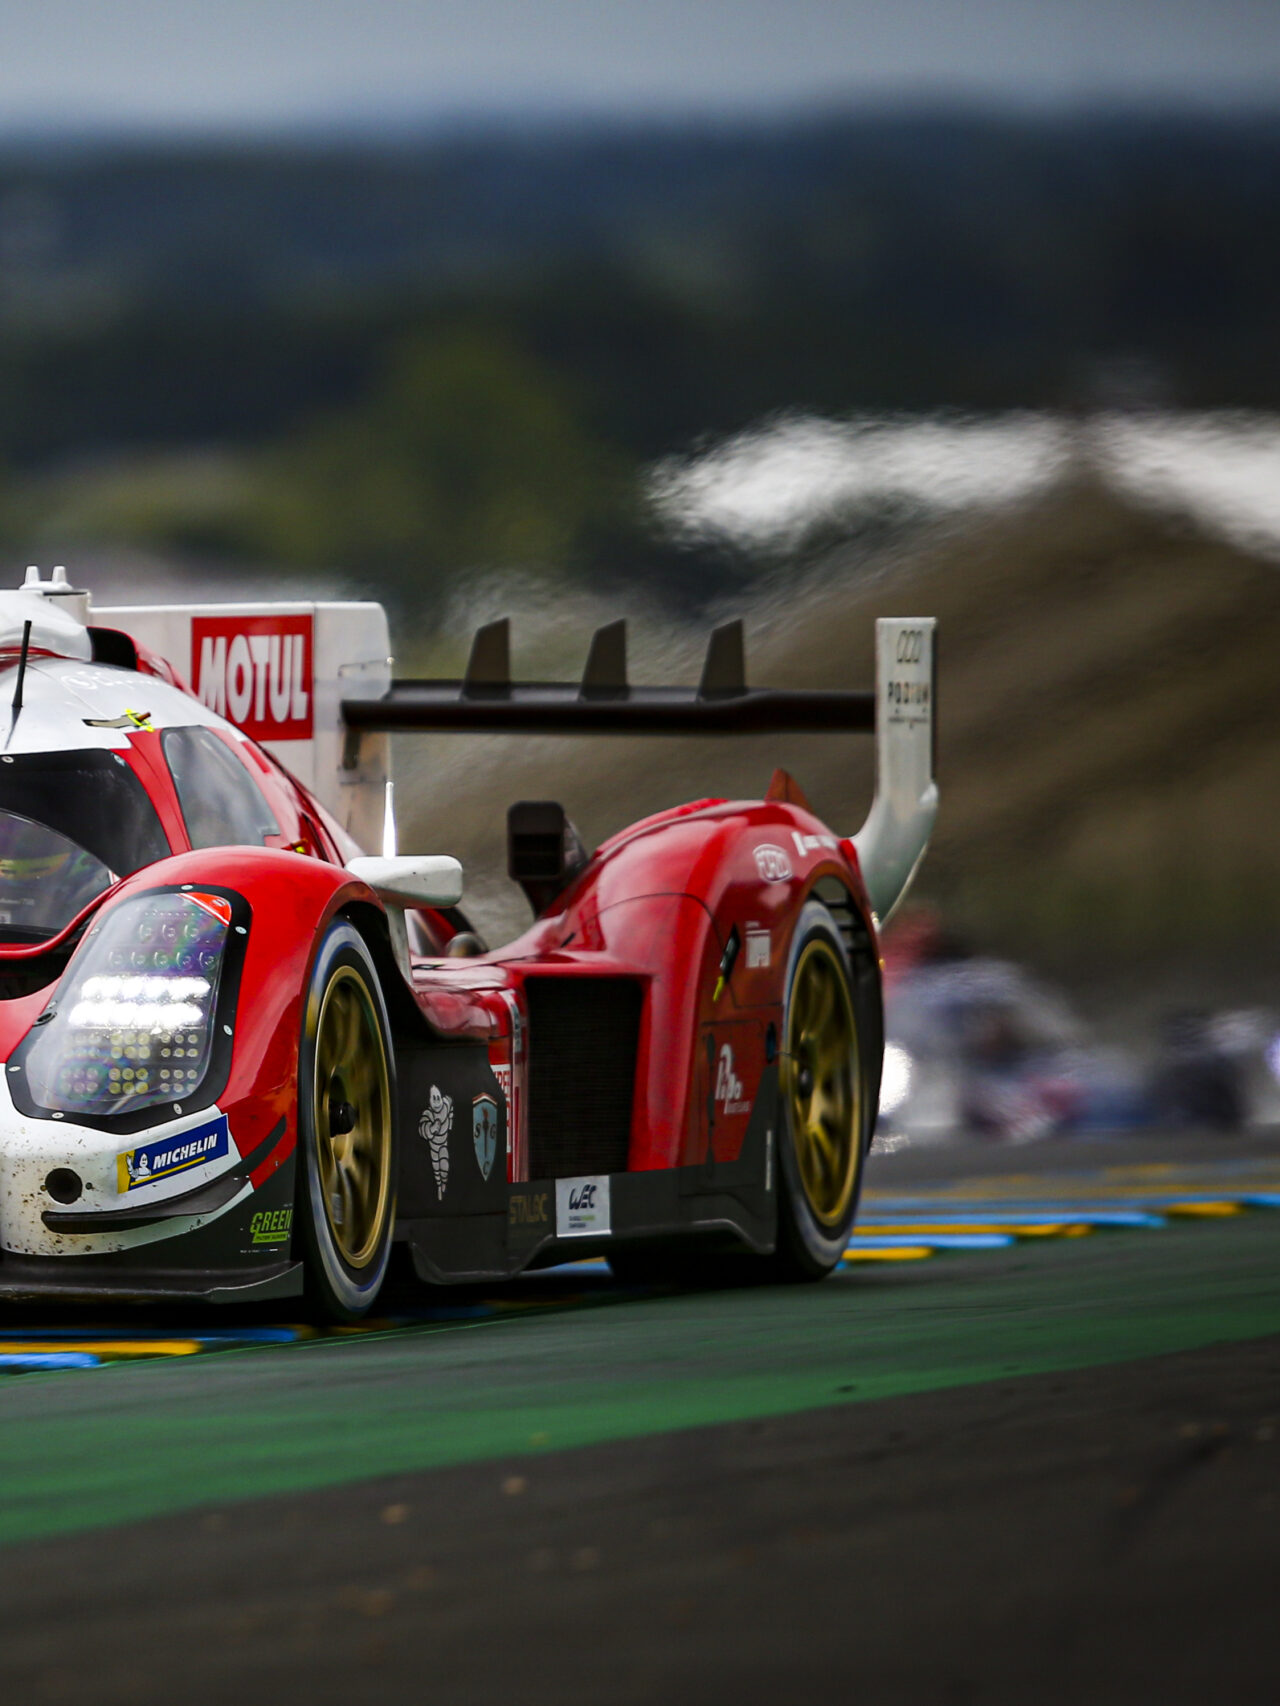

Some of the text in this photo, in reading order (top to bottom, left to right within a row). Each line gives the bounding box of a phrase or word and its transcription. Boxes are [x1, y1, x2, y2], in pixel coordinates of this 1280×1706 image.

[197, 634, 309, 724] MOTUL
[152, 1133, 218, 1171] MICHELIN
[568, 1184, 597, 1210] WEC
[250, 1209, 293, 1234] GREEN
